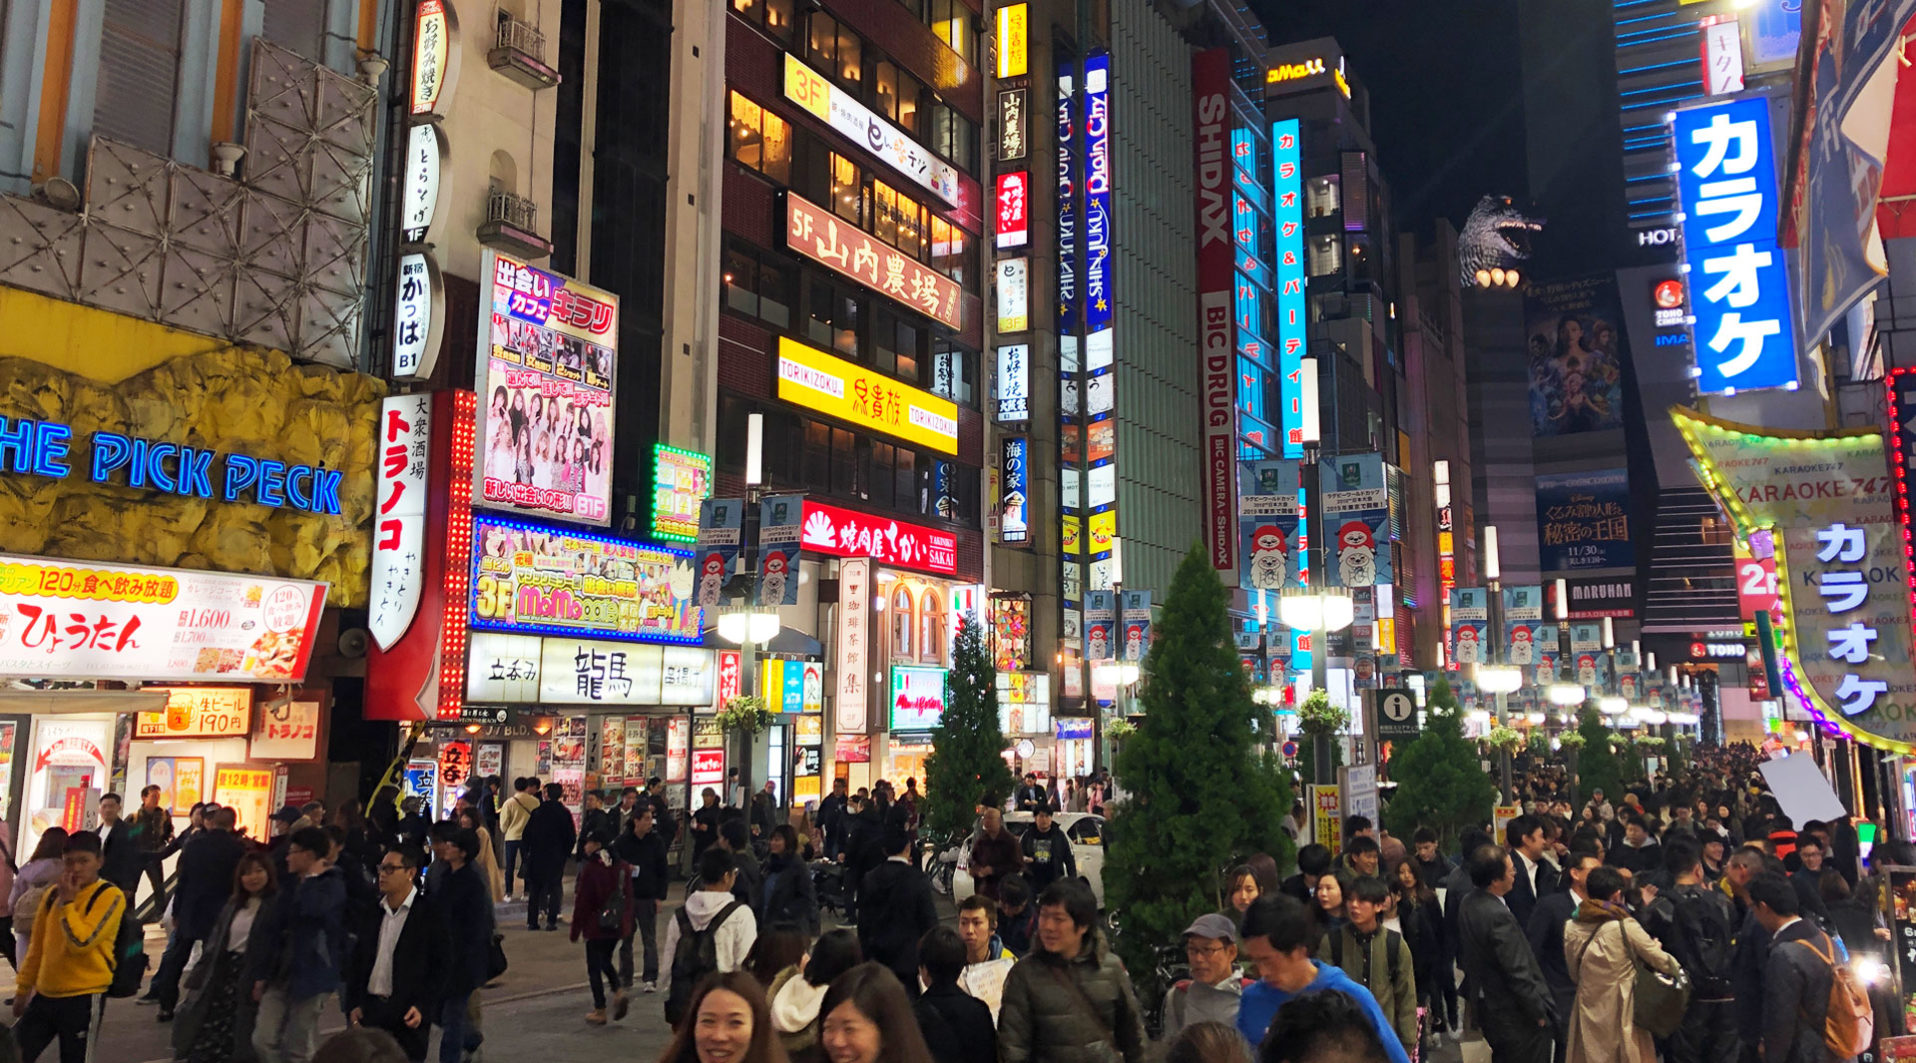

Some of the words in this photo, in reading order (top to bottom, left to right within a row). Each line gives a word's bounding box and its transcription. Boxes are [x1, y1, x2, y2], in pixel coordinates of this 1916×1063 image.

[796, 69, 822, 106] 3F
[1004, 93, 1020, 150] 山内農場
[1199, 93, 1228, 248] SHIDAX
[408, 229, 423, 241] 1F
[792, 208, 814, 241] 5F
[1089, 209, 1107, 298] SHINJUKU
[1691, 113, 1781, 378] カラオケ
[403, 263, 423, 276] 新宿
[496, 260, 550, 298] 出会い
[816, 219, 940, 315] 山内農場
[511, 293, 549, 321] カフェ
[551, 289, 614, 335] キラリ
[1207, 306, 1226, 348] BIC
[400, 353, 417, 368] B1
[781, 360, 837, 393] TORIKIZOKU
[1208, 355, 1228, 427] DRUG
[410, 398, 427, 479] 大衆酒場
[910, 408, 953, 435] TORIKIZOKU
[1006, 442, 1021, 488] 海の家
[1214, 439, 1224, 458] BIC
[91, 431, 216, 498] PICK
[224, 452, 343, 514] PECK
[379, 410, 409, 551] トラノコ
[1215, 460, 1226, 509] CAMERA
[1737, 477, 1846, 504] KARAOKE
[577, 494, 603, 515] B1F
[839, 521, 884, 558] 焼肉屋
[884, 521, 927, 562] さかい
[1544, 516, 1629, 544] 秘密の王国
[929, 550, 954, 566] SAKAI
[82, 575, 174, 599] 食べ飲み放題
[476, 576, 513, 618] 3F
[1572, 583, 1632, 600] MARUHAN
[17, 603, 142, 654] ひょうたん
[847, 600, 860, 664] 珈琲茶館
[1815, 522, 1888, 716] カラオケ
[1707, 643, 1746, 657] TOHO
[488, 658, 536, 681] 立呑み
[574, 645, 632, 700] 龍馬
[844, 672, 860, 694] 集
[200, 697, 245, 712] 生ビール
[200, 714, 241, 732] 190円
[268, 724, 314, 739] トラノコ
